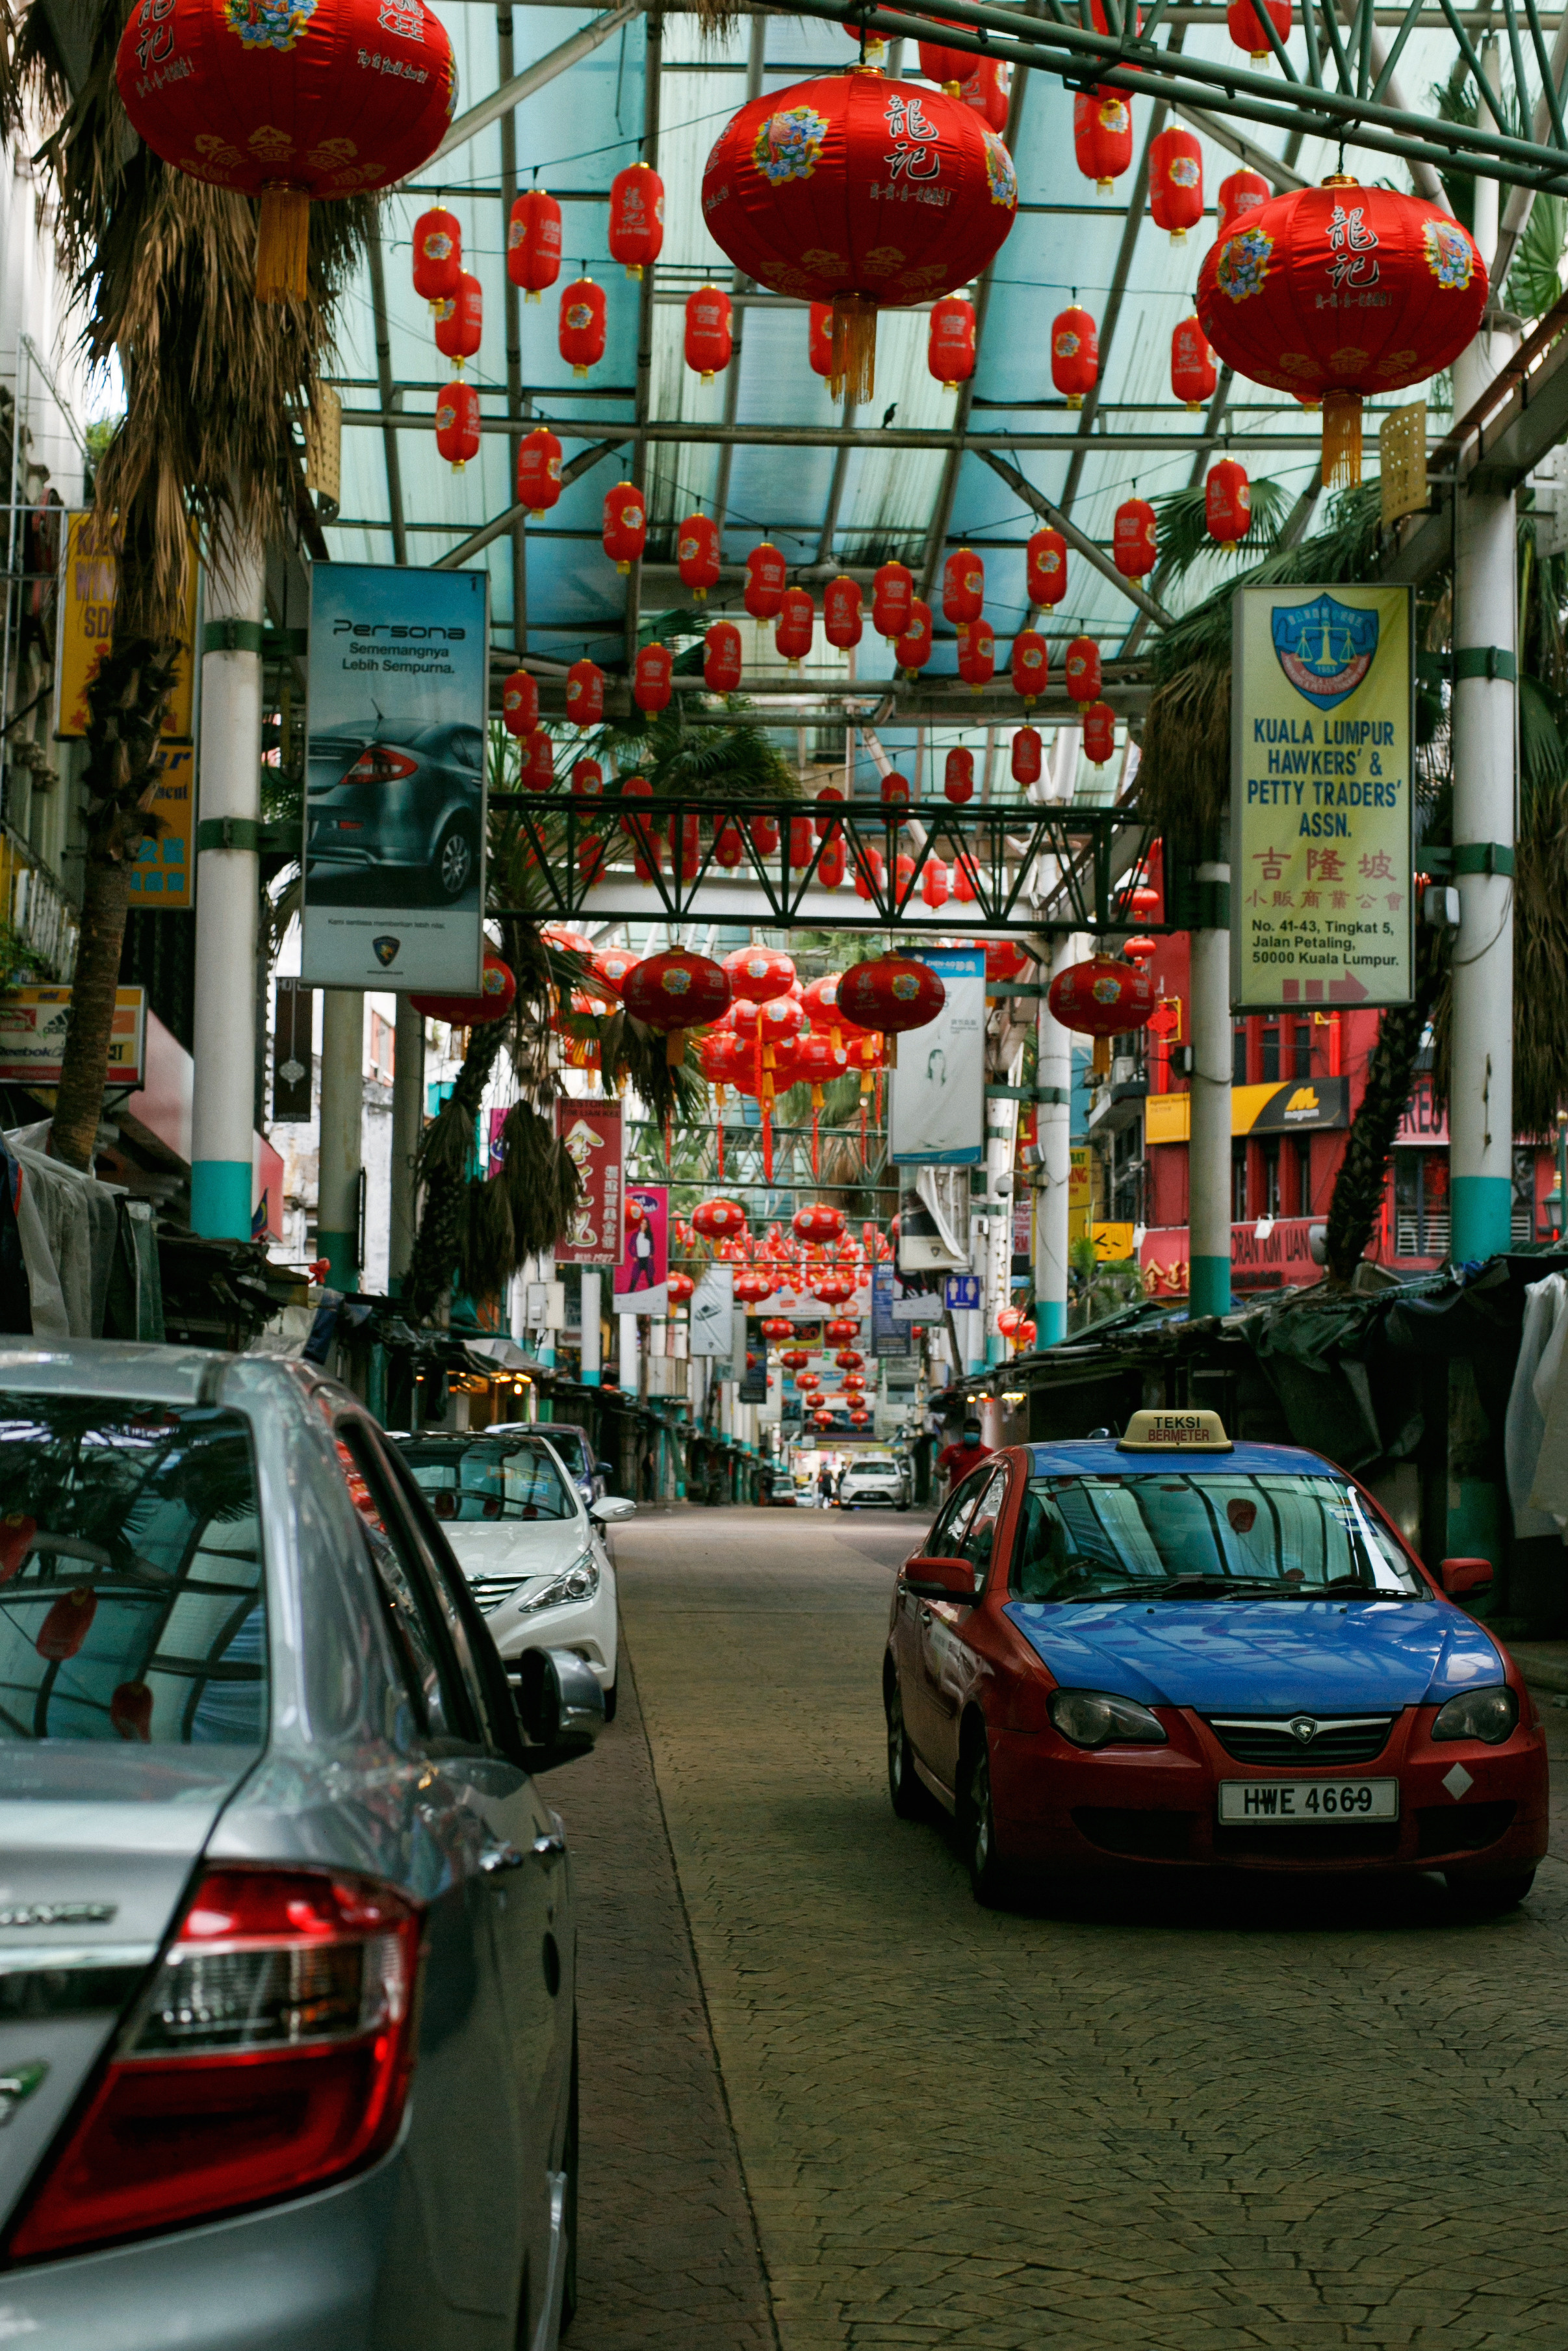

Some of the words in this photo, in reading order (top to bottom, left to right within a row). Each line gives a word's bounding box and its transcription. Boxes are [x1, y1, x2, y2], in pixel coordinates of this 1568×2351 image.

[378, 5, 424, 42] KEE
[884, 94, 940, 180] 龍記
[1326, 205, 1379, 289] 龍記
[333, 619, 466, 640] Persona
[350, 642, 449, 660] Sememangnya
[342, 658, 378, 671] Lebih
[383, 660, 454, 674] Sempurna.
[1254, 719, 1314, 744] KUALA
[1324, 721, 1394, 745] LUMPUR
[1268, 749, 1361, 775] HAWKERS'
[1370, 752, 1382, 775] &
[1248, 780, 1304, 804] PETTY
[1313, 780, 1401, 806] TRADERS'
[1300, 812, 1352, 837] ASSN.
[1253, 847, 1396, 882] 吉隆坡
[1252, 919, 1274, 931] No.
[1280, 920, 1320, 933] 41-43,
[1326, 921, 1378, 936] Tingkat
[1383, 922, 1394, 936] 5,
[1253, 936, 1290, 947] Jalan
[1294, 936, 1355, 951] Petaling,
[1253, 952, 1294, 964] 50000
[1300, 953, 1339, 964] Kuala
[1344, 953, 1398, 968] Lumpur.
[1148, 1429, 1209, 1441] BERMETER
[1154, 1417, 1200, 1428] TEKSI
[1244, 1788, 1295, 1814] HWE
[1305, 1787, 1372, 1813] 4669
